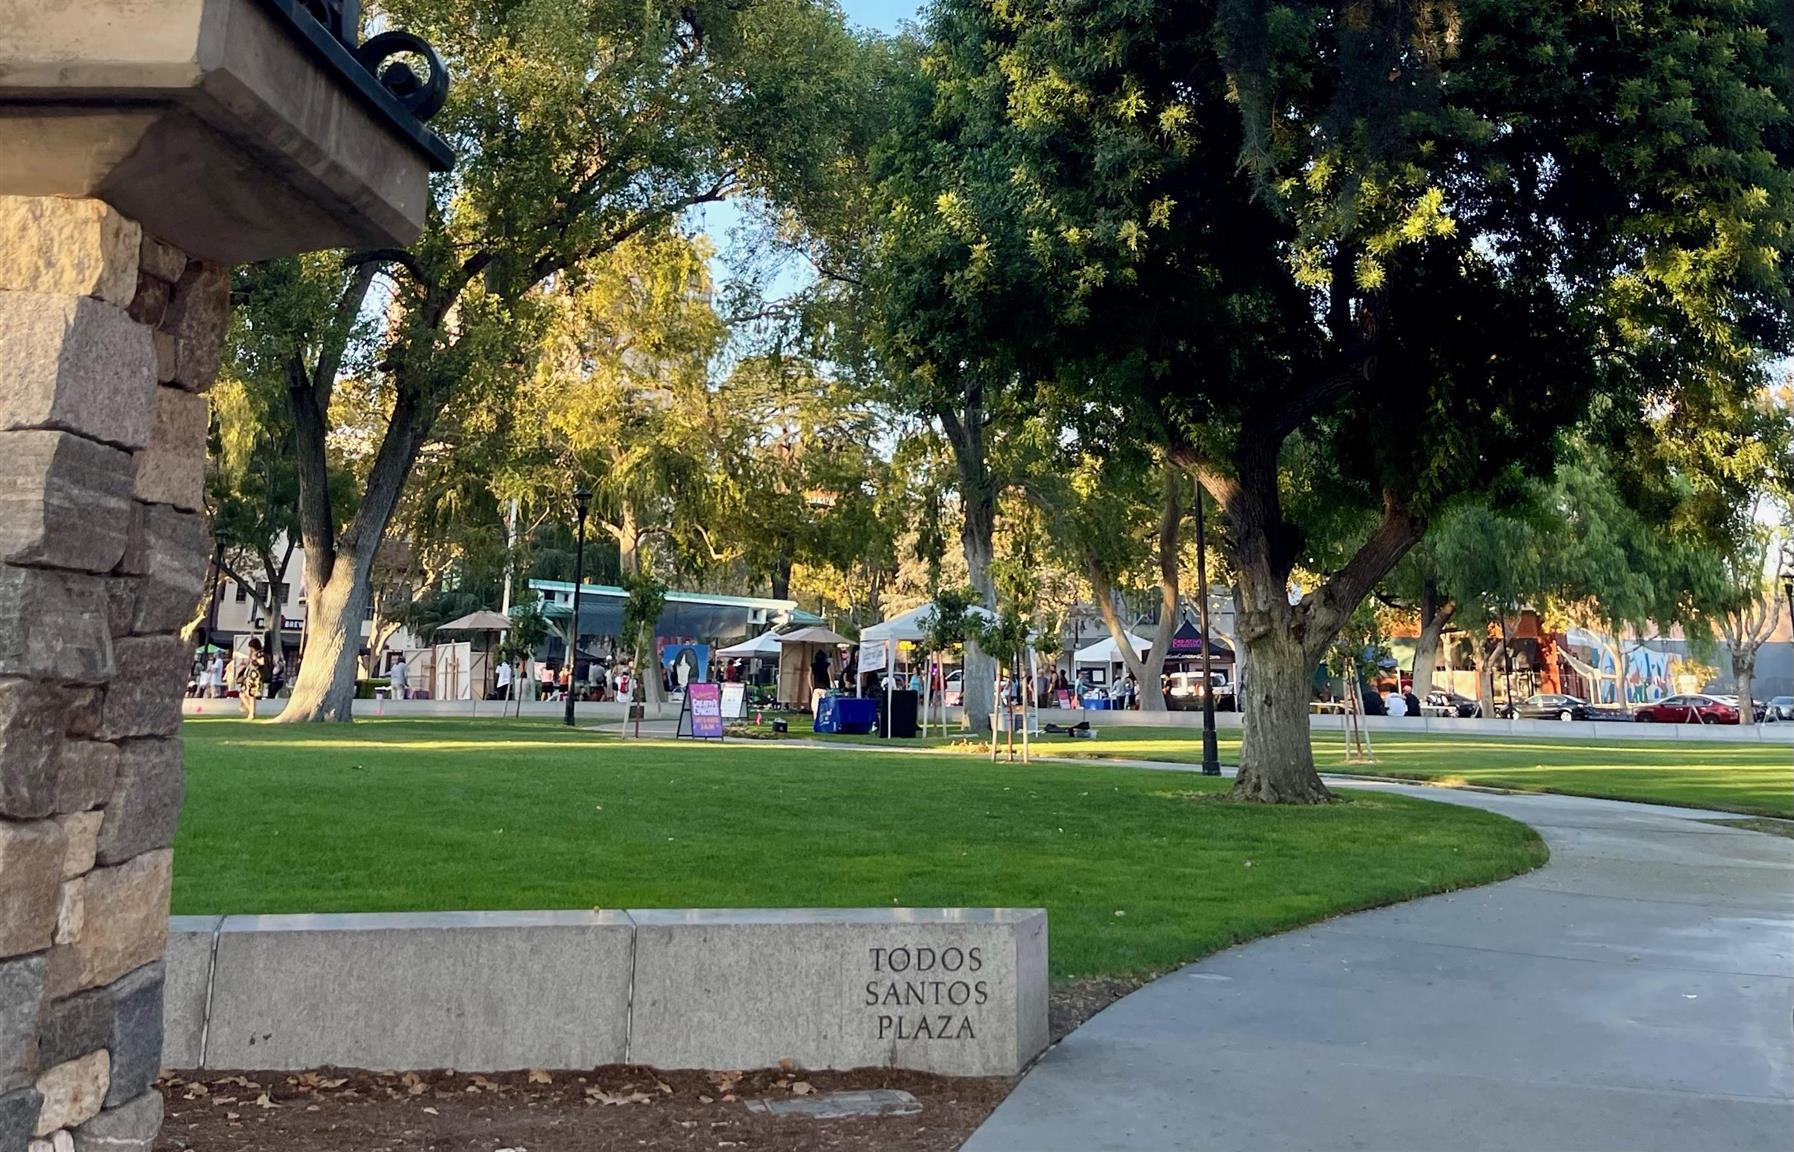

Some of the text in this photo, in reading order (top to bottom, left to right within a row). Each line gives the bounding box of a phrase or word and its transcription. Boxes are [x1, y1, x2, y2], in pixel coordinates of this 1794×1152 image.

[869, 947, 982, 972] TODOS
[866, 981, 988, 1006] SANTOS
[876, 1015, 976, 1039] PLAZA
